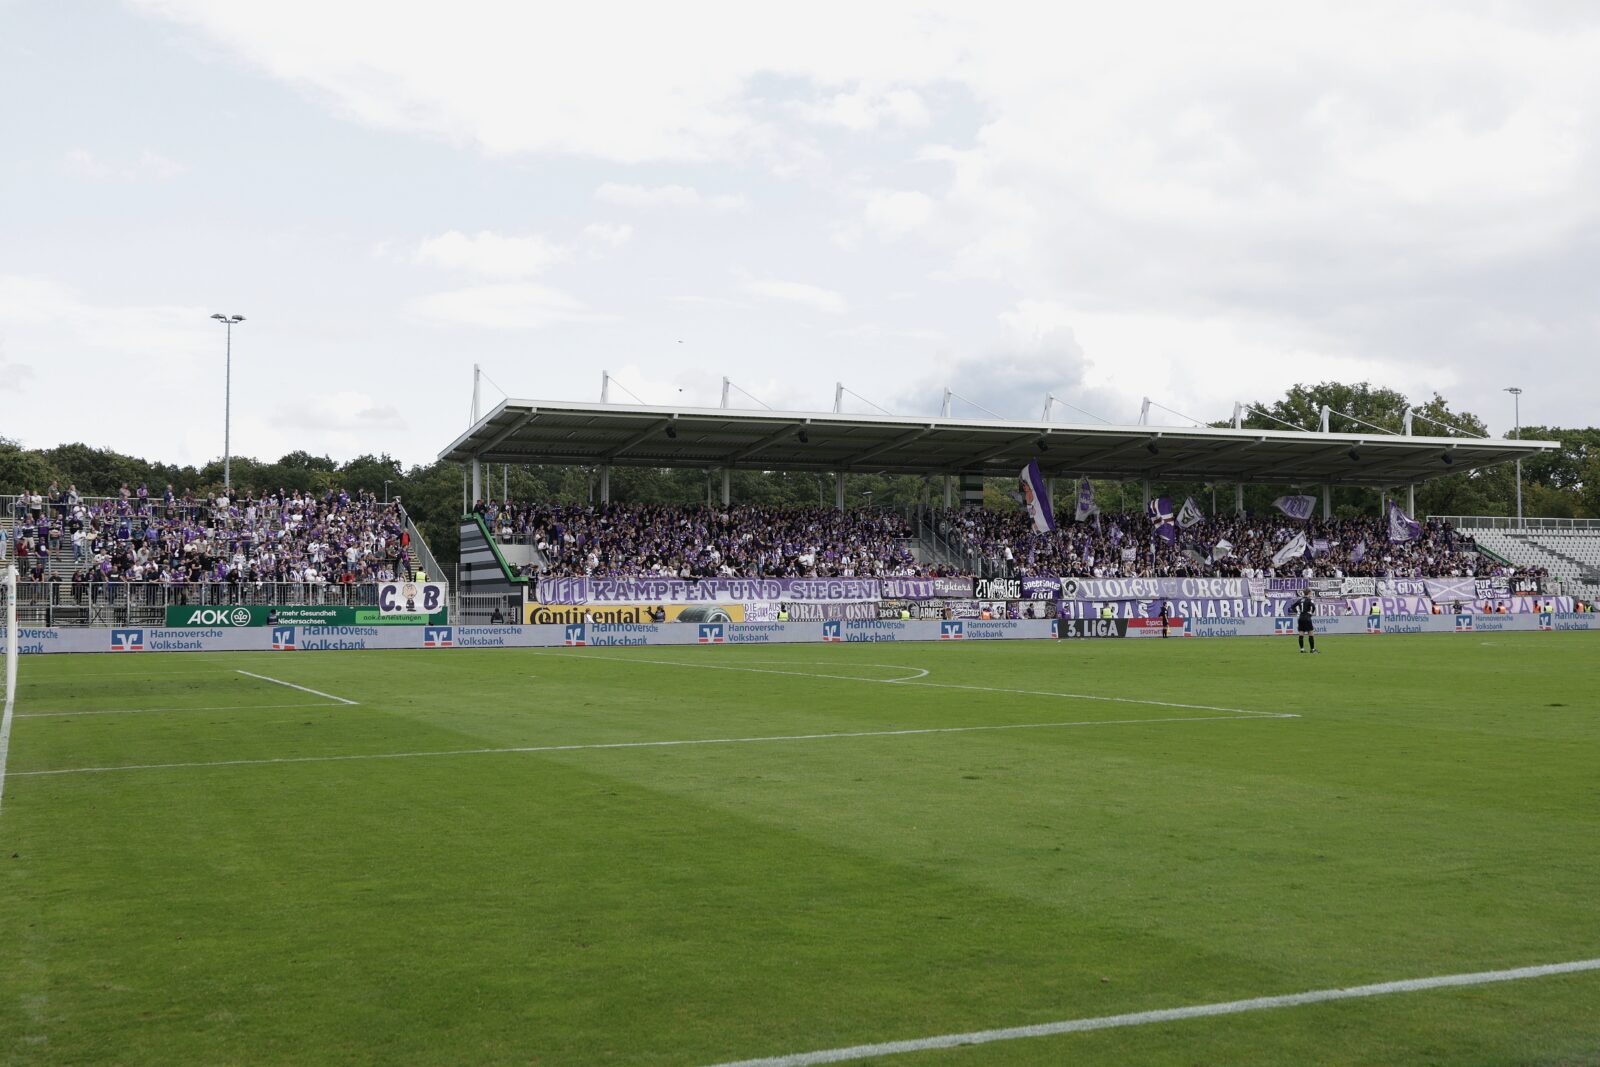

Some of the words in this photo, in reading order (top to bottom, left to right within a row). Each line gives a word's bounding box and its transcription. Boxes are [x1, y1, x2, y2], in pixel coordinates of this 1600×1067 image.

[593, 577, 718, 601] KÄMPFEN
[728, 580, 781, 600] UND
[789, 580, 879, 600] SIEGEN!
[1181, 578, 1243, 598] CREW
[1397, 582, 1424, 593] GUYS
[423, 585, 440, 610] B
[745, 603, 757, 612] DIE
[846, 604, 875, 619] OSNA
[187, 610, 230, 625] AOK
[745, 613, 757, 621] DER
[920, 608, 943, 619] ARMEE
[592, 623, 658, 632] Hannoversche
[846, 620, 905, 629] Hannoversche
[1068, 620, 1080, 637] 3.
[1084, 620, 1119, 637] LIGA
[150, 629, 223, 638] Hannoversche
[302, 626, 378, 636] Hannoversche
[458, 627, 522, 635] Hannoversche
[967, 630, 1003, 638] Volksbank
[458, 637, 504, 646] Volksbank
[591, 636, 648, 645] Volksbank
[728, 633, 769, 641] Volksbank
[846, 632, 896, 642] Volksbank
[150, 640, 202, 649] Volksbank
[302, 639, 366, 650] Volksbank
